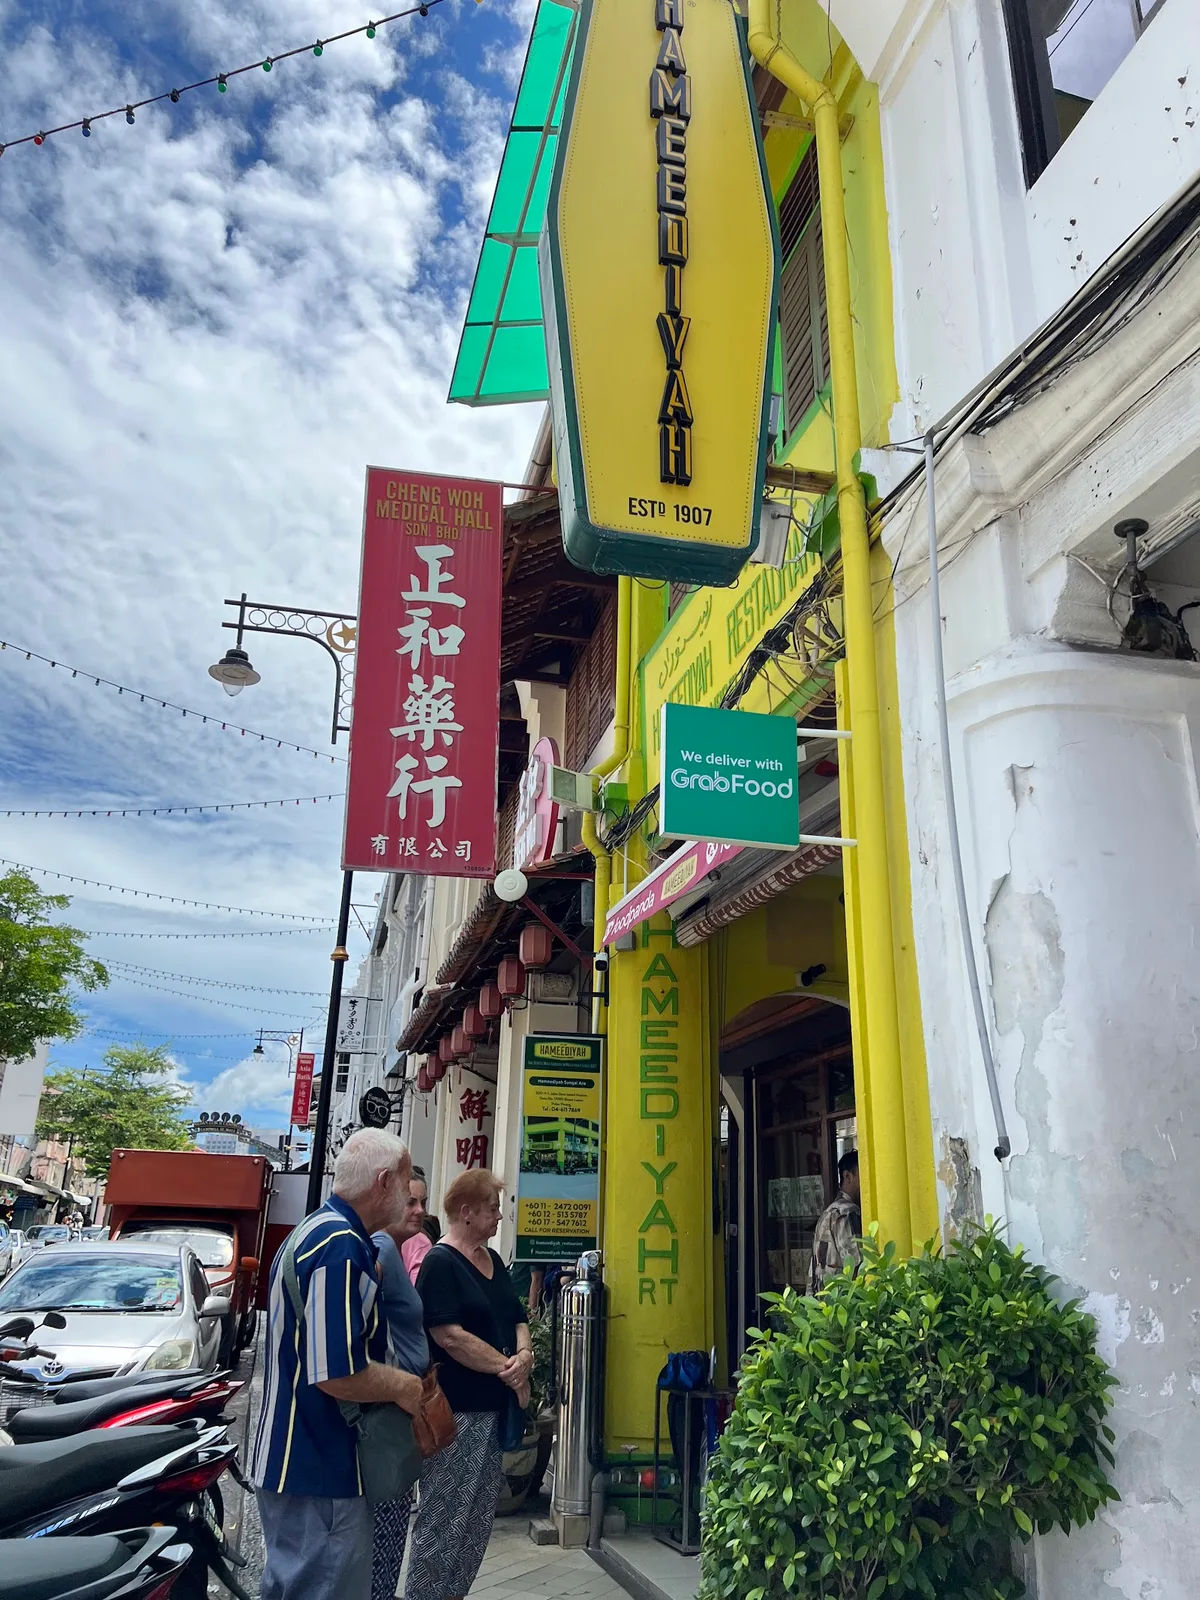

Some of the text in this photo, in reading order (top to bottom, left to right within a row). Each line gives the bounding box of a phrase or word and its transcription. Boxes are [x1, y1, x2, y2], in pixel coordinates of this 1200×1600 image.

[650, 0, 693, 486] HAMEEDIYAH
[386, 481, 483, 510] CHENG WOH
[376, 499, 493, 531] MEDICAL HALL
[672, 504, 713, 527] 1907
[386, 544, 467, 829] 正和藥行
[680, 750, 783, 772] We deliver with
[670, 768, 793, 799] GrabFood
[370, 834, 472, 862] 有限公司
[611, 889, 656, 936] foodpanda
[539, 1045, 586, 1057] HAMEEDIYAH
[637, 916, 680, 1274] HAMEEDIYAH
[456, 1088, 492, 1170] 鮮明
[525, 1202, 539, 1210] +60
[573, 1203, 591, 1211] 0091
[528, 1218, 542, 1226] +60
[639, 1278, 678, 1305] RT
